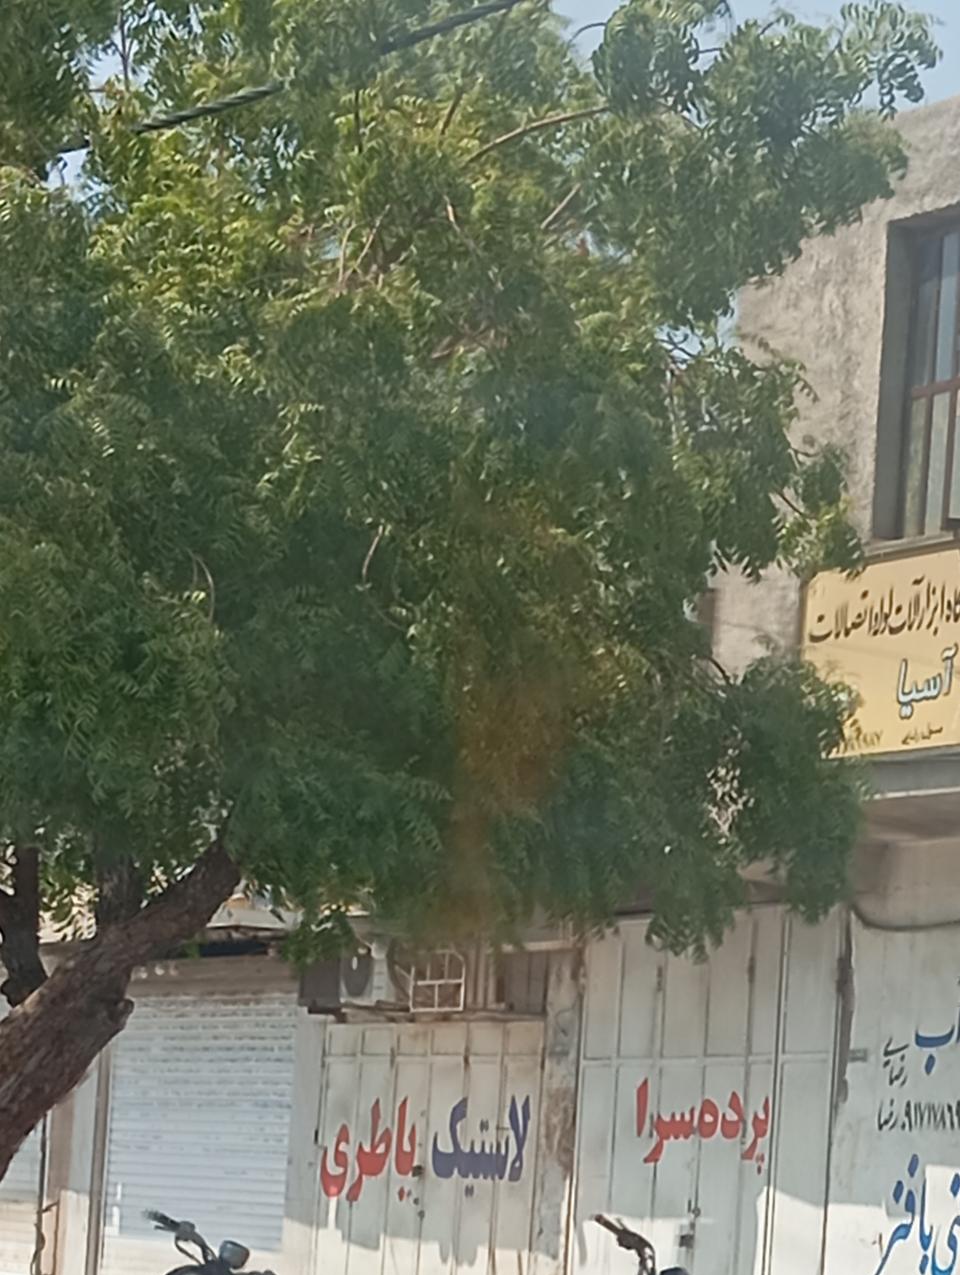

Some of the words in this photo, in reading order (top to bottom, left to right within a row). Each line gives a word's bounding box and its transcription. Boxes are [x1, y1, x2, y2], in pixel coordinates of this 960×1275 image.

[897, 643, 959, 719] آسیا
[320, 1096, 417, 1202] باطری
[432, 1094, 531, 1197] لاستیک
